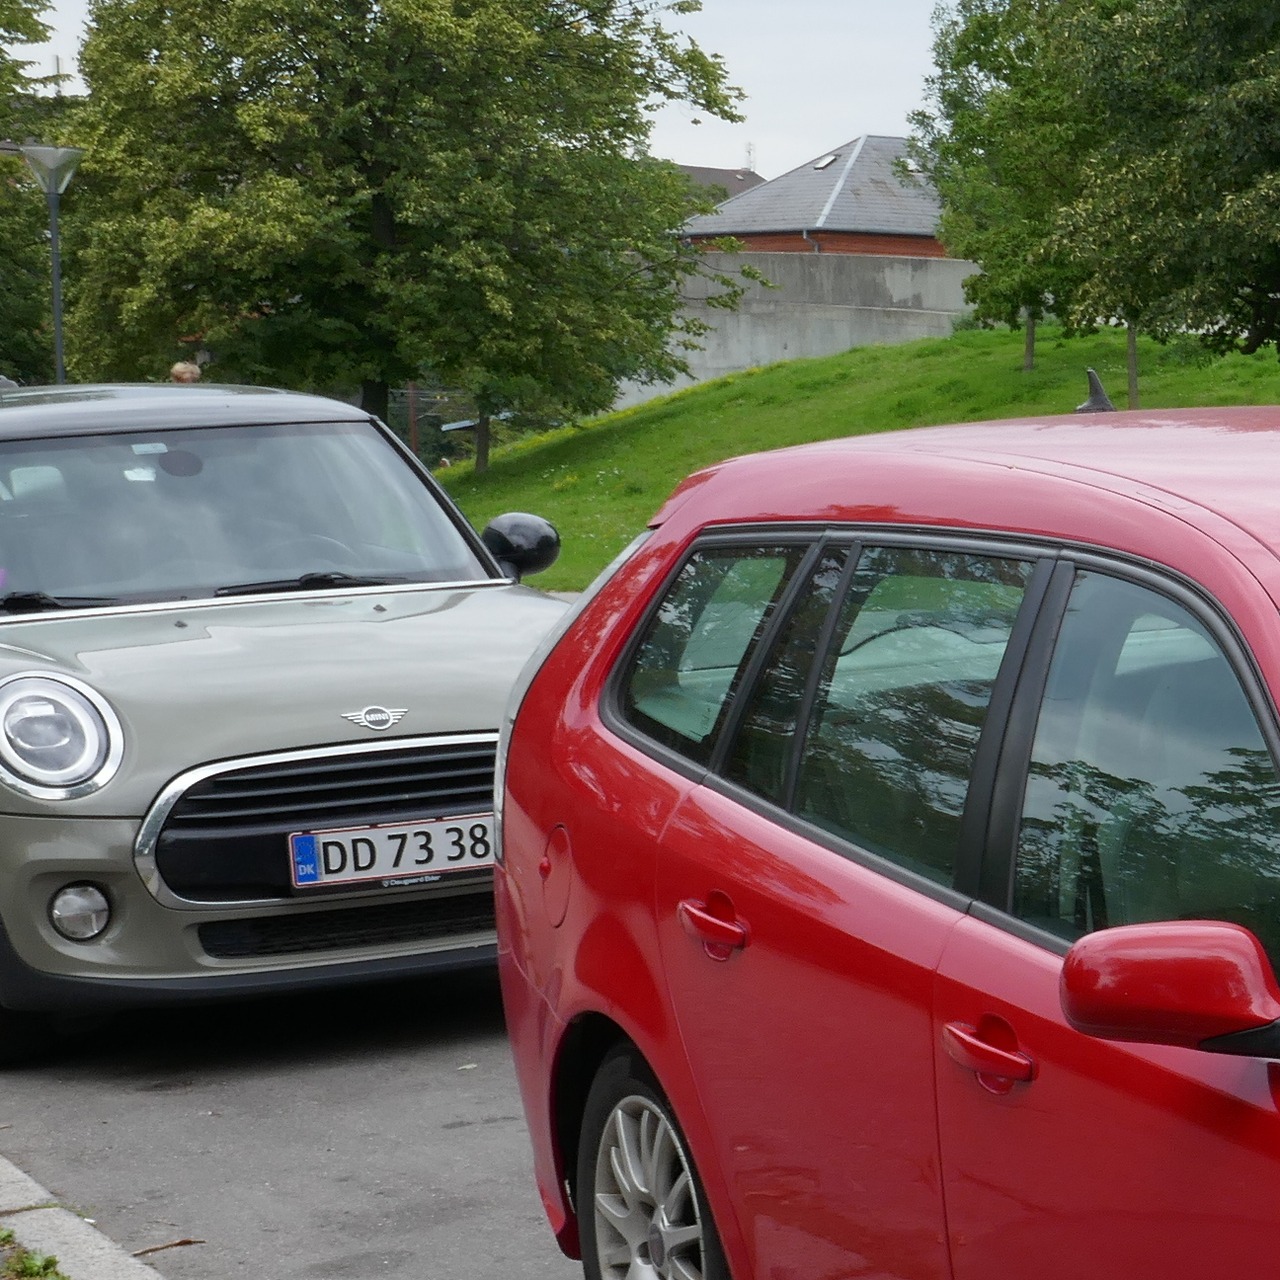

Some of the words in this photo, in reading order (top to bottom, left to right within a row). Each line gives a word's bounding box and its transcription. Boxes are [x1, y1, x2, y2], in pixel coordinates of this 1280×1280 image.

[322, 837, 377, 875] DD
[387, 830, 435, 868] 73
[299, 864, 315, 876] DK
